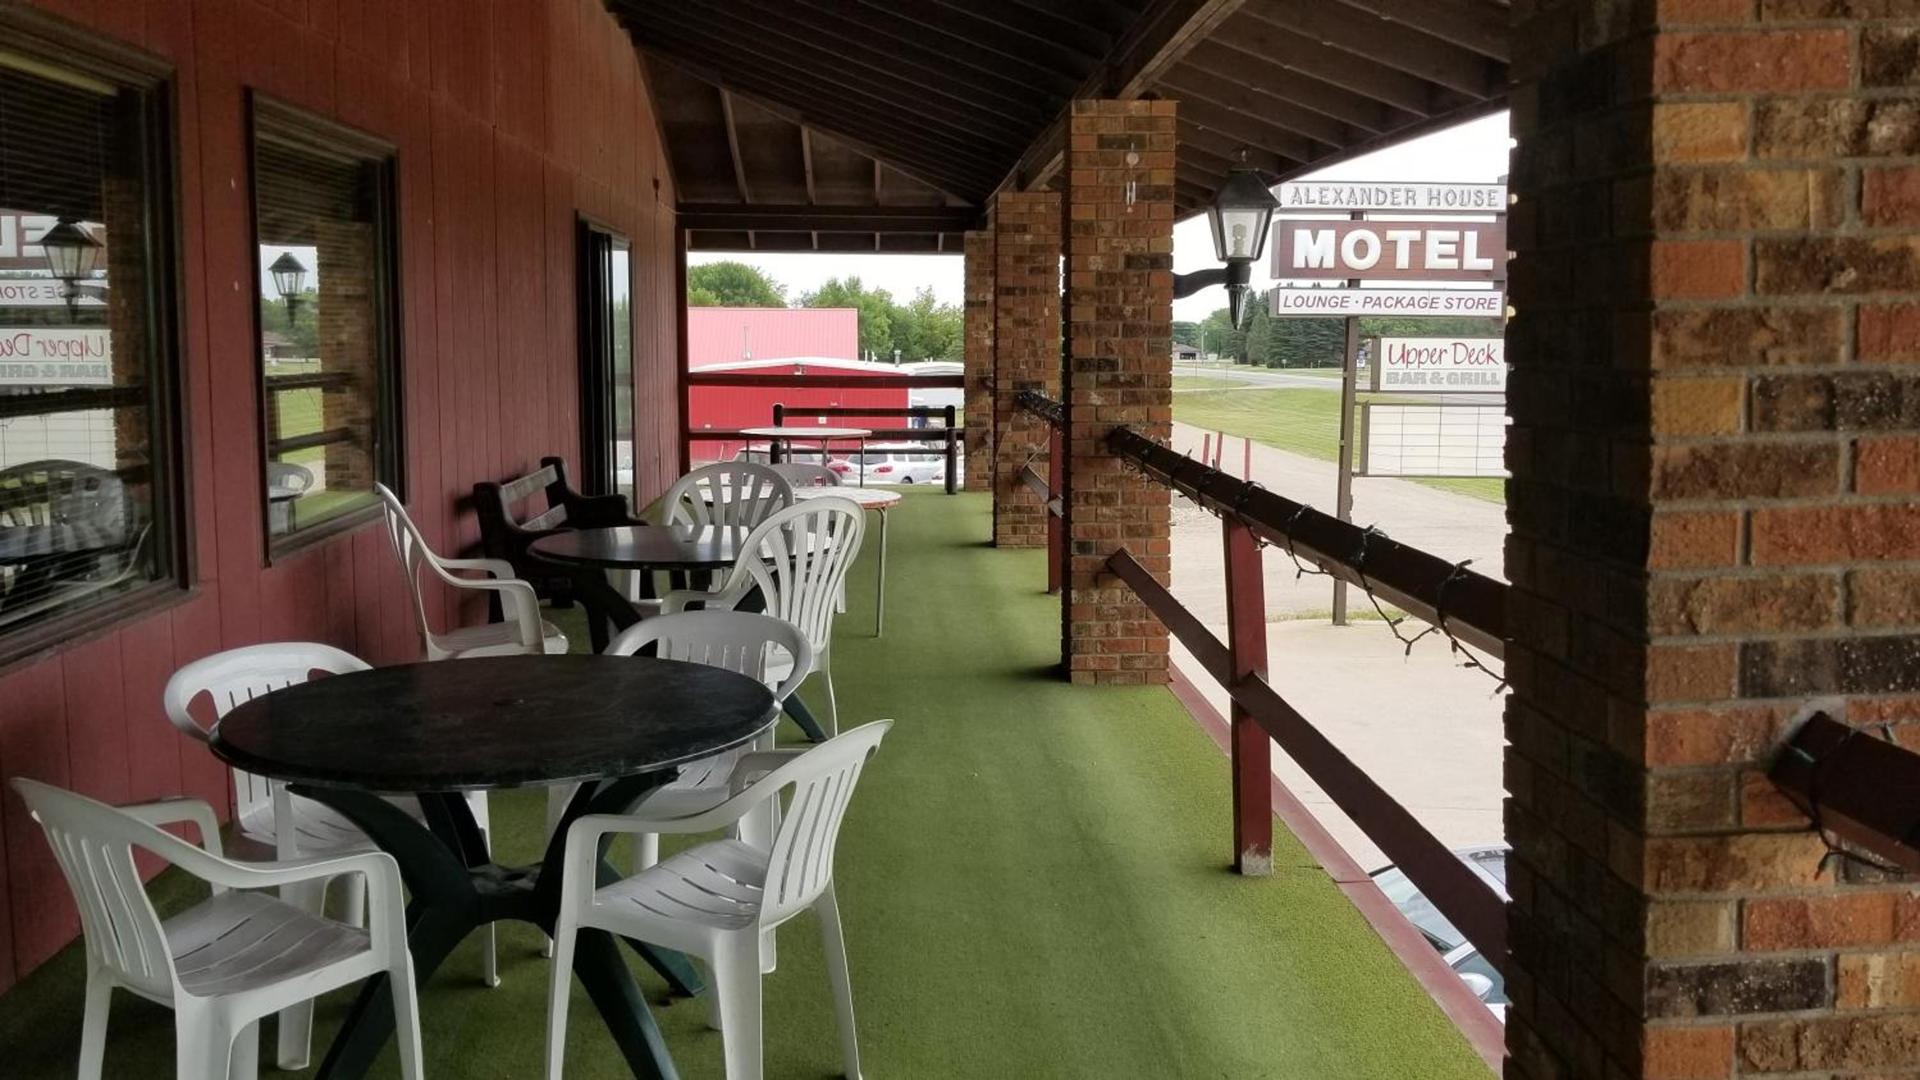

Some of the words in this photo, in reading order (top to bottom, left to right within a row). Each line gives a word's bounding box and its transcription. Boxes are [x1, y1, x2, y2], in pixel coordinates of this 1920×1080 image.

[1291, 186, 1417, 206] ALEXANDER
[1426, 188, 1499, 207] HOUSE
[1293, 228, 1494, 271] MOTEL
[1283, 295, 1351, 309] LOUNGE
[1362, 296, 1441, 310] PACKAGE
[1444, 297, 1498, 311] STORE
[1388, 343, 1447, 370] Upper
[1451, 342, 1499, 366] Deck
[1386, 371, 1427, 385] BAR
[1429, 371, 1444, 385] &
[1446, 371, 1500, 386] GRILL
